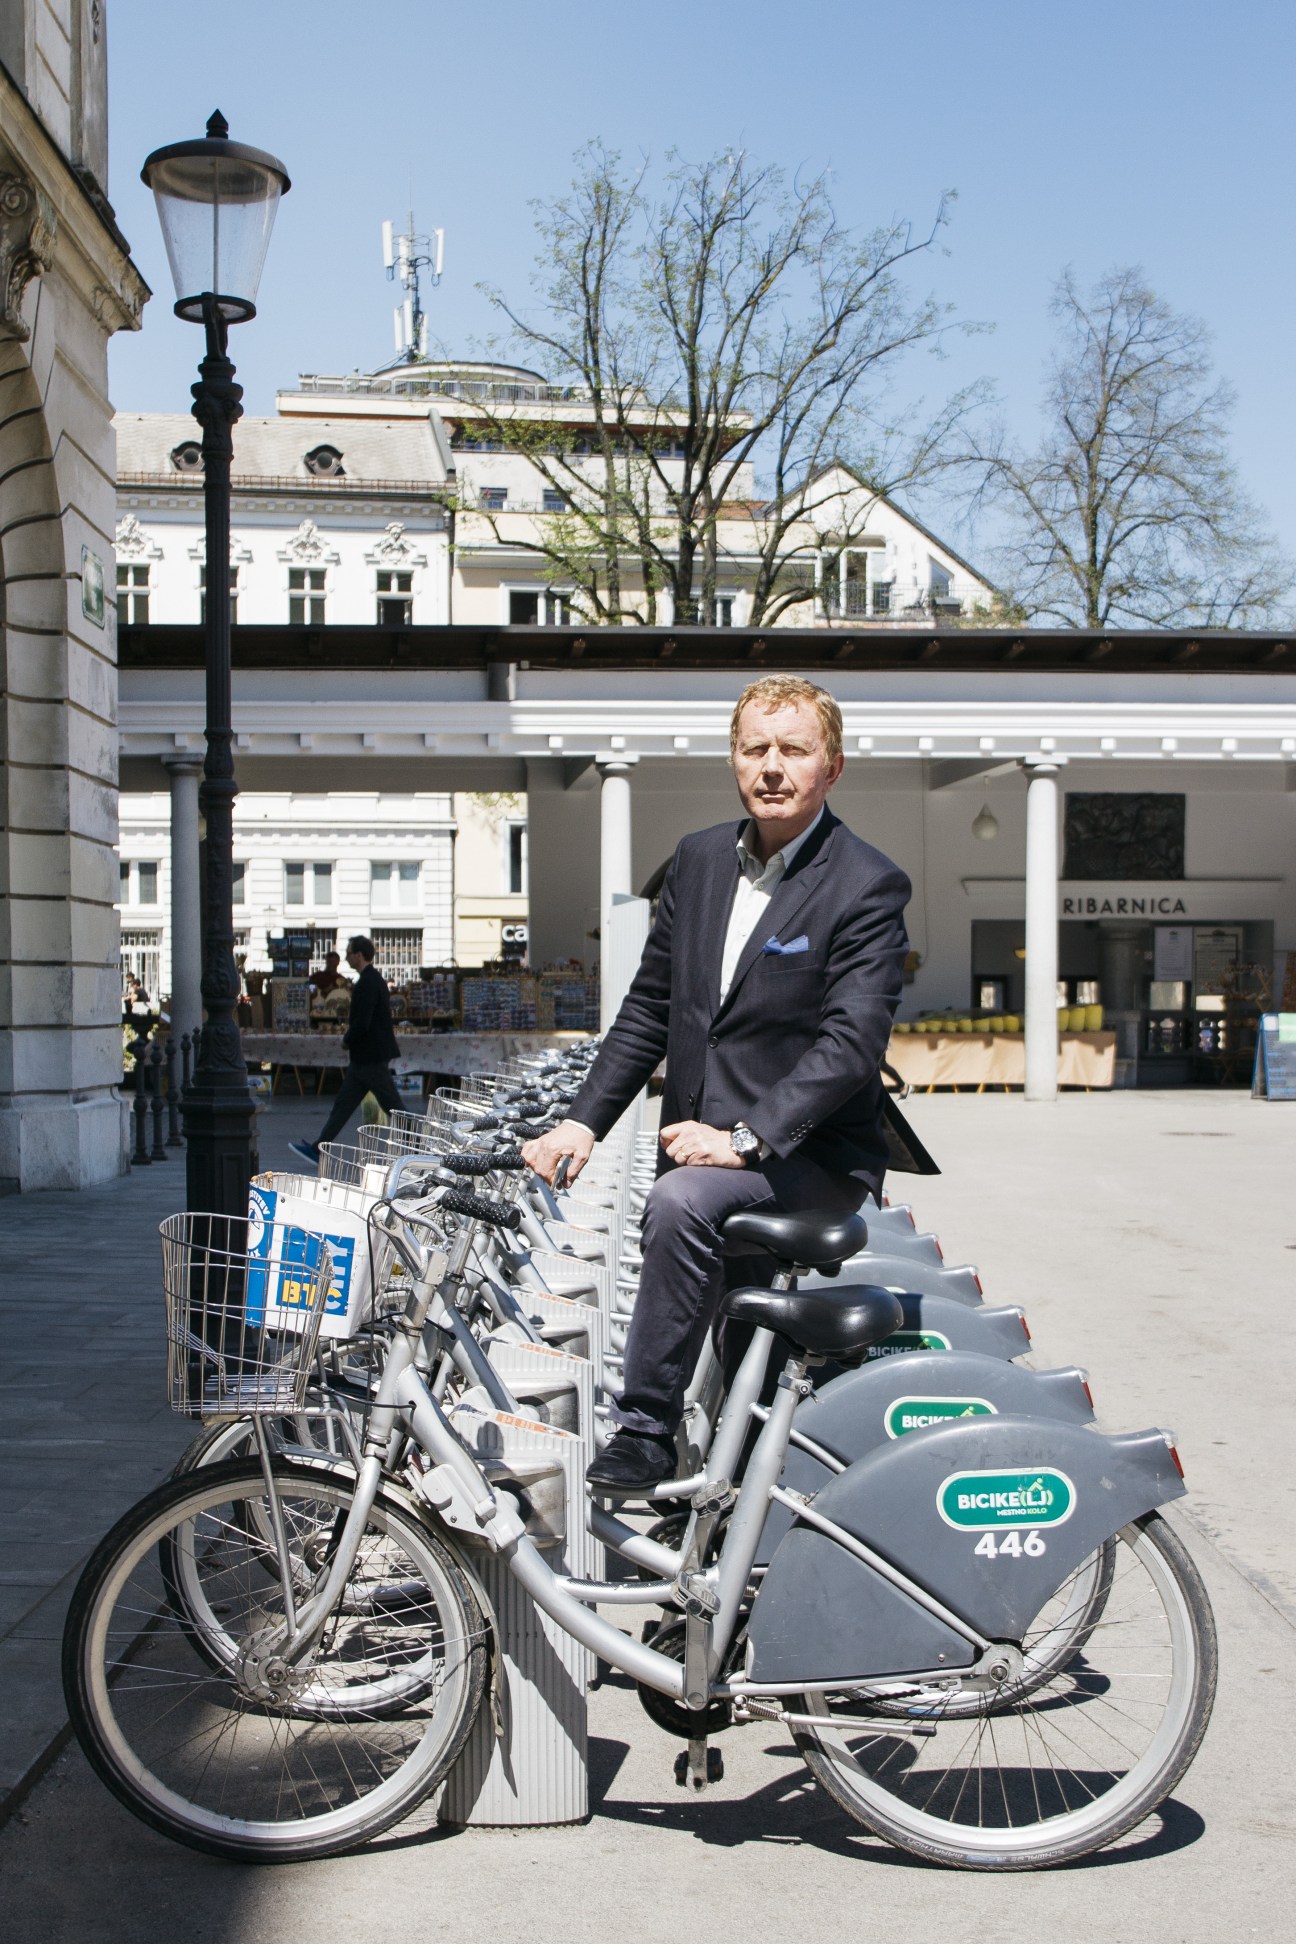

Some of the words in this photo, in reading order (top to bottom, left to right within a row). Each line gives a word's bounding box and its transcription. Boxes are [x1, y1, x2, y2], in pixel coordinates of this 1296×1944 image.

[1063, 898, 1187, 914] RIBARNICA
[282, 1279, 342, 1310] BTC
[958, 1490, 1054, 1510] BICIKE(LJ)
[996, 1508, 1027, 1517] MESTNO
[1027, 1507, 1048, 1515] KOLO
[974, 1530, 1046, 1558] 446
[1010, 1849, 1065, 1863] SCHWALBE
